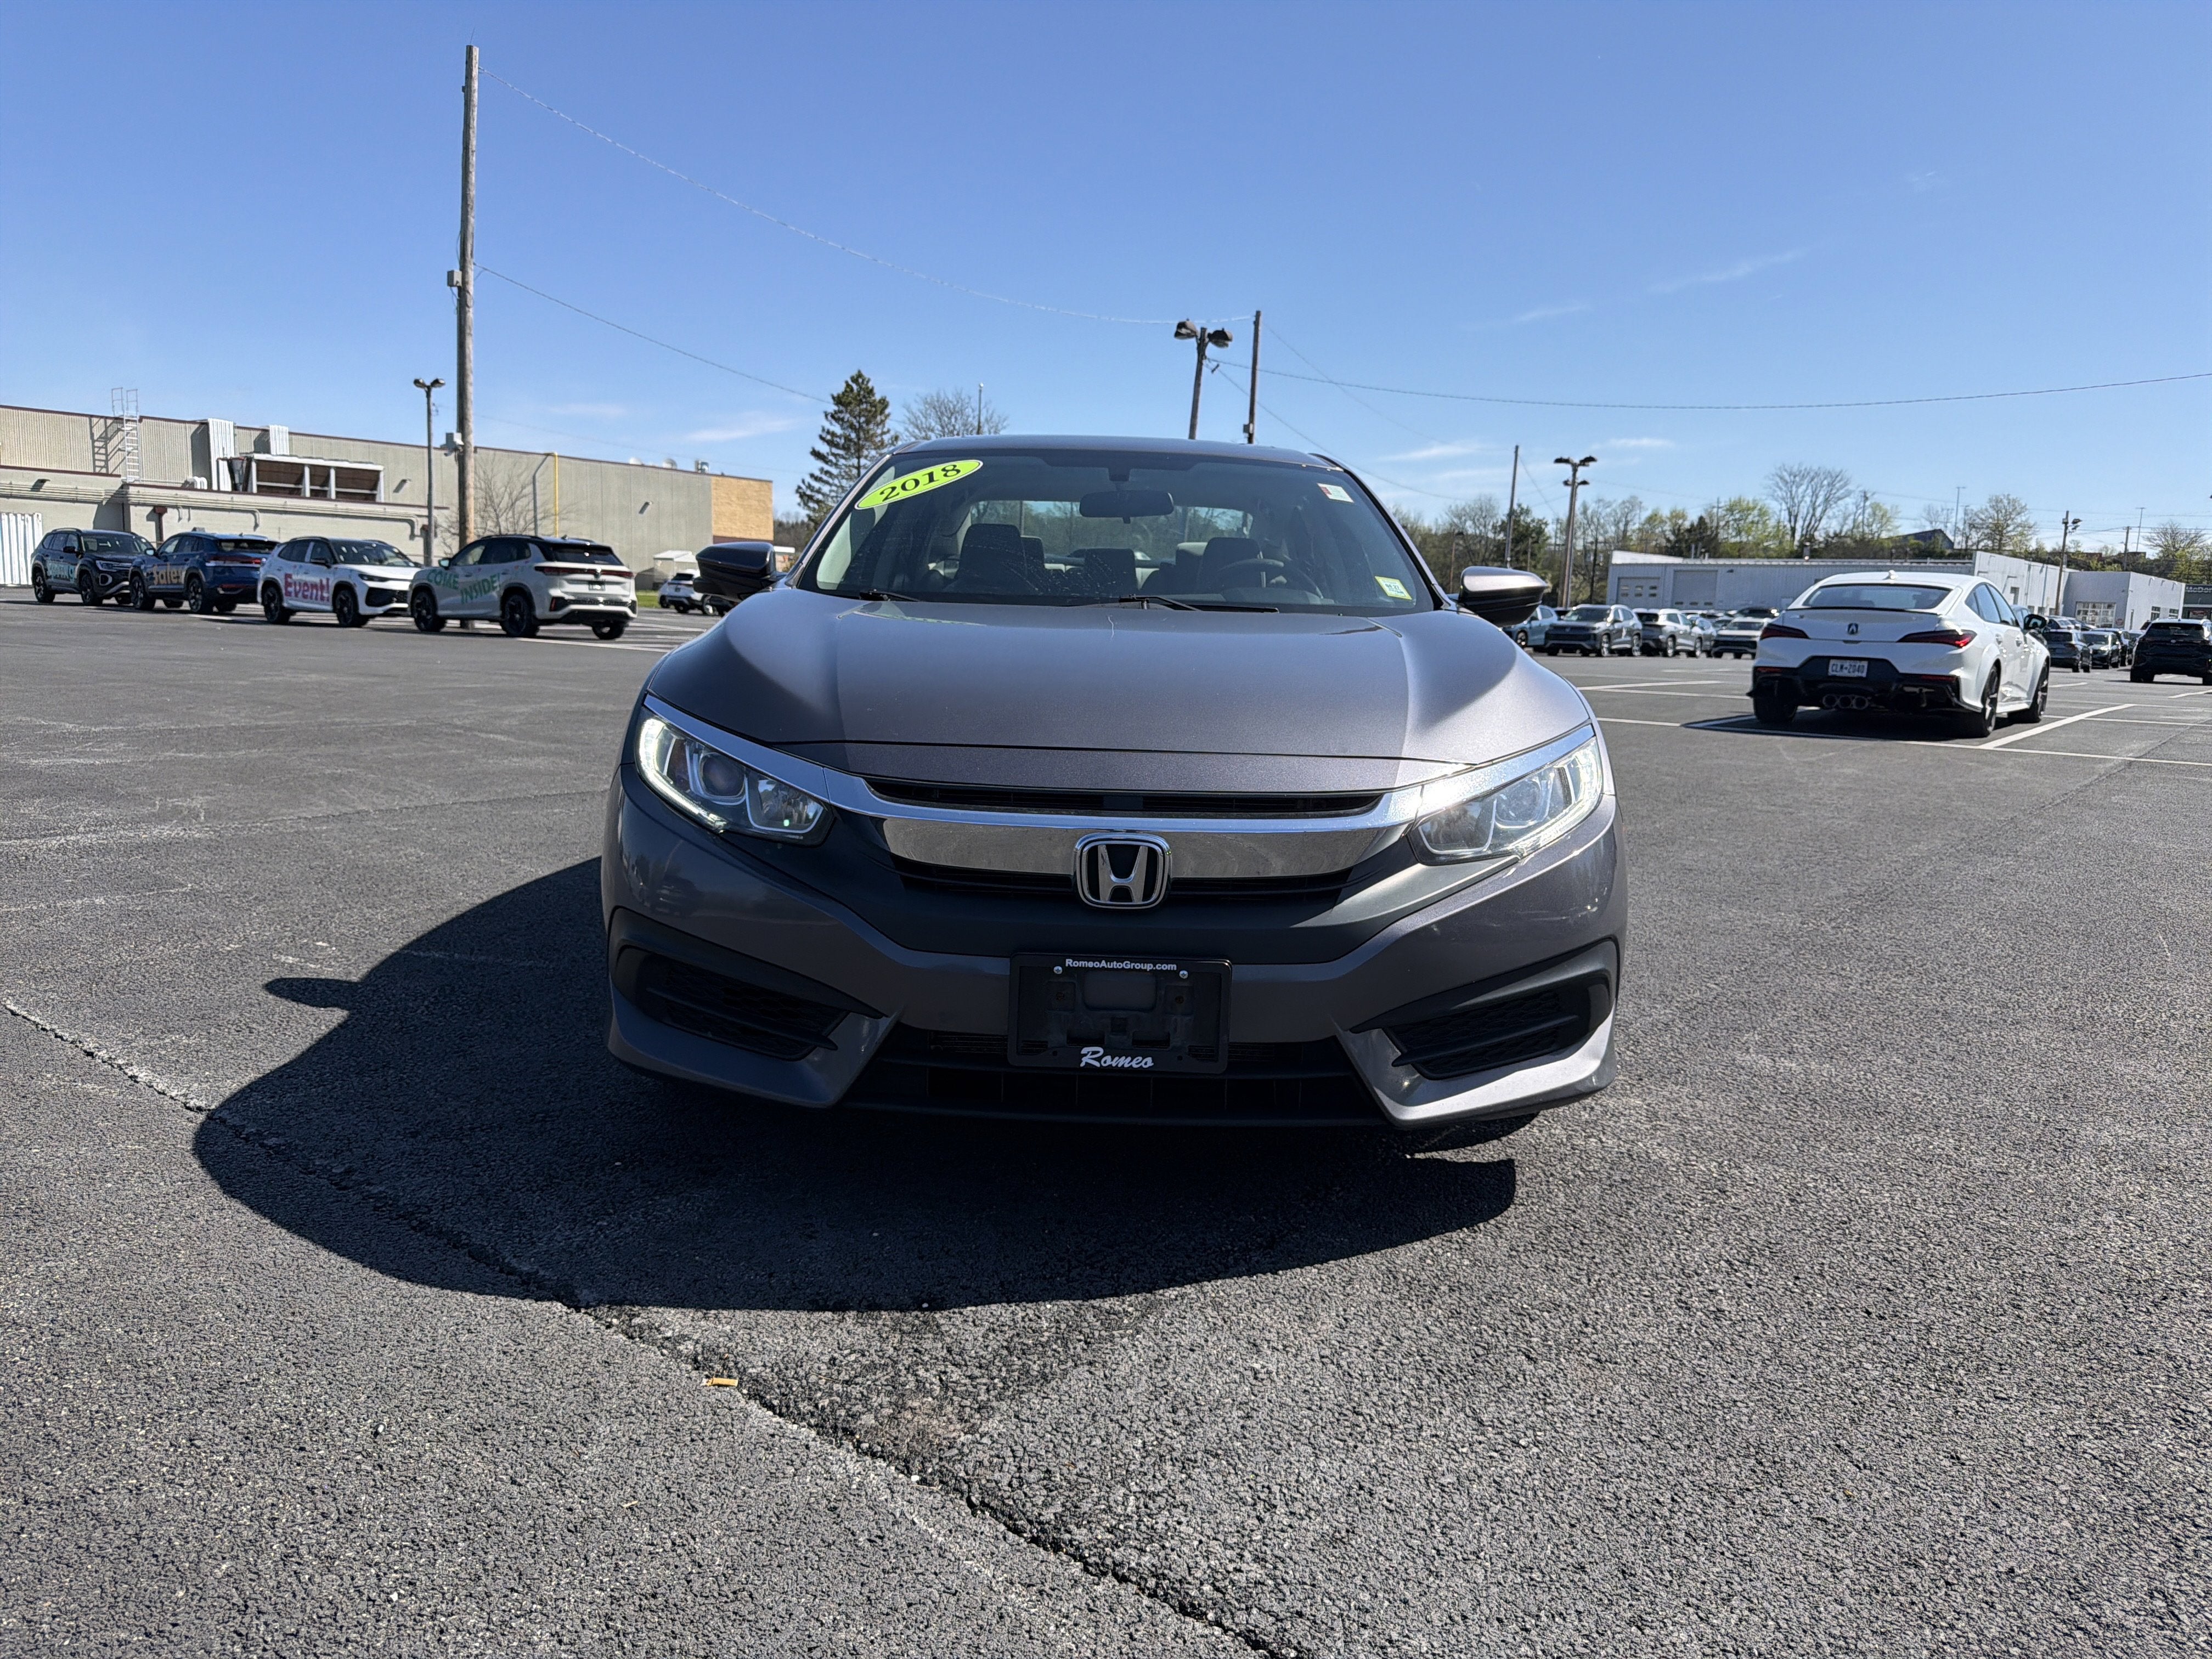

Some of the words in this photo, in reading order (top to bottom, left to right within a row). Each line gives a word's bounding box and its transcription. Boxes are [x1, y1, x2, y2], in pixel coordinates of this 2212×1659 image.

[879, 464, 961, 502] 2018
[284, 572, 330, 601] Event!
[1065, 958, 1177, 971] RomeoAutoGroup.com
[1080, 1046, 1154, 1068] Romeo
